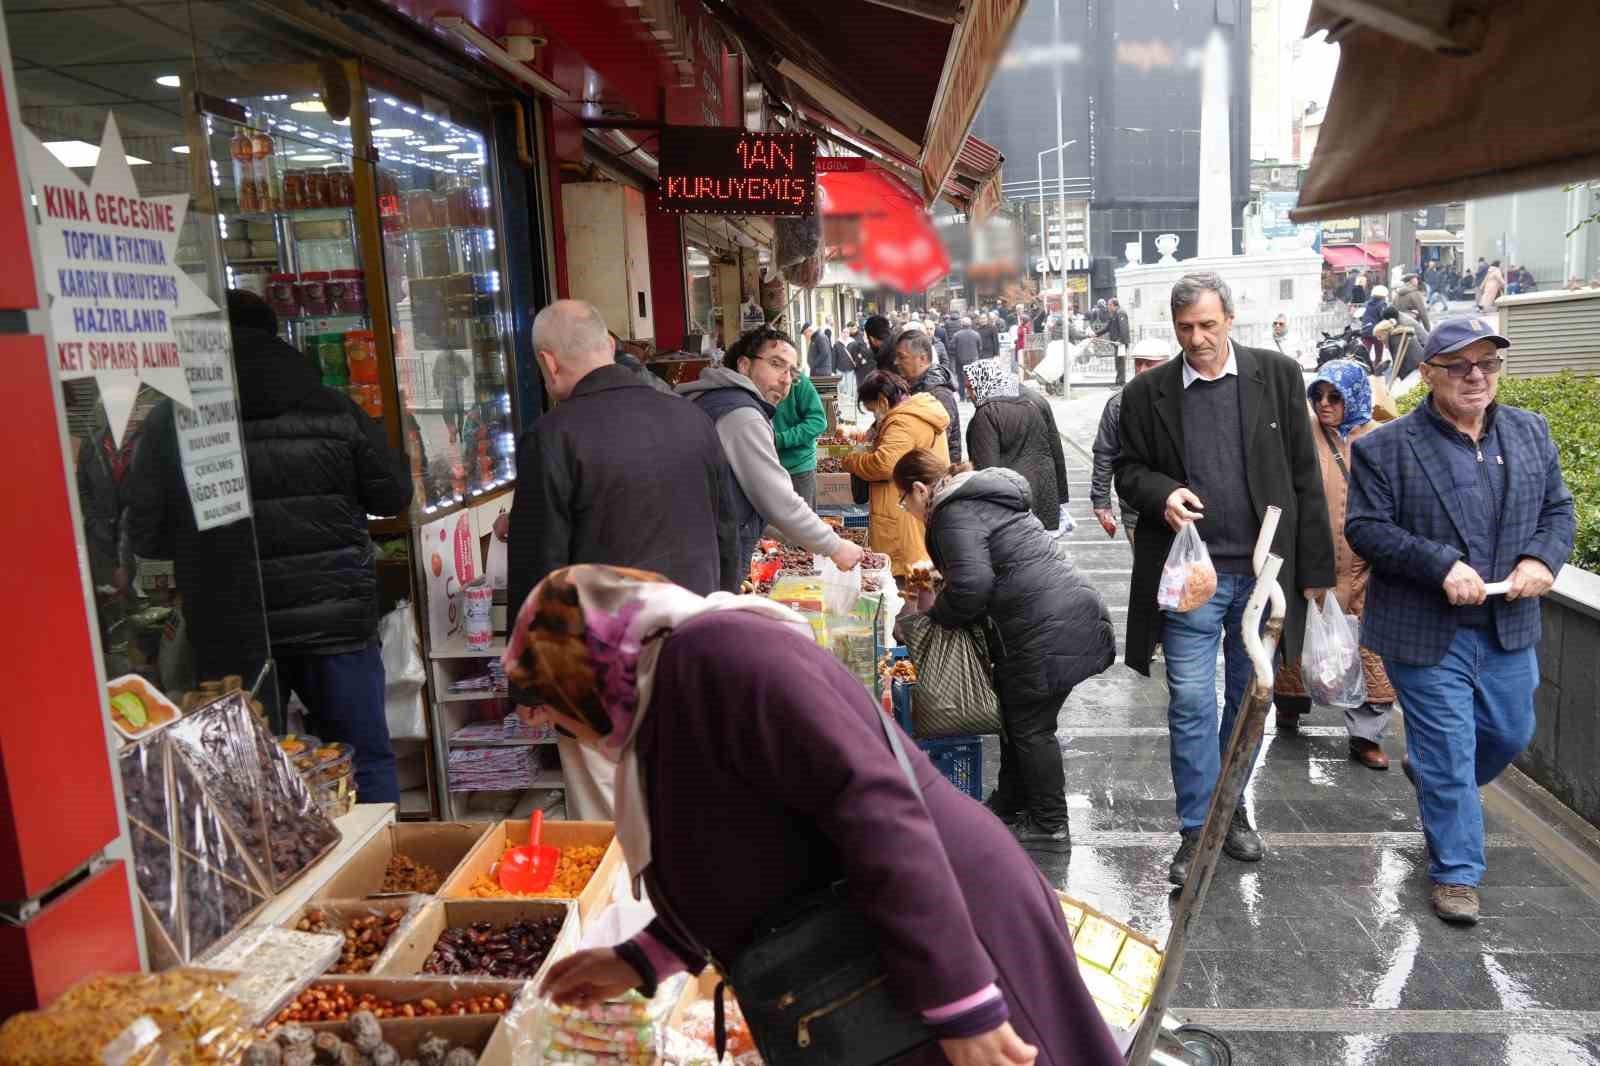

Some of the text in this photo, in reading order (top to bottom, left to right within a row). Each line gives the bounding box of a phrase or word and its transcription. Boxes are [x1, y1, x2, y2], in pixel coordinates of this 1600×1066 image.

[667, 173, 805, 206] KURUYEMİŞ
[44, 184, 176, 233] KINA GECESİNE
[62, 228, 168, 266] TOPTAN FİYATINA
[58, 268, 179, 309] KARIŞIK KURUYEMİŞ
[73, 307, 168, 333] HAZIRLANIR
[87, 340, 139, 377] SİPARİŞ
[142, 341, 181, 369] ALINIR
[218, 476, 245, 497] TOZU
